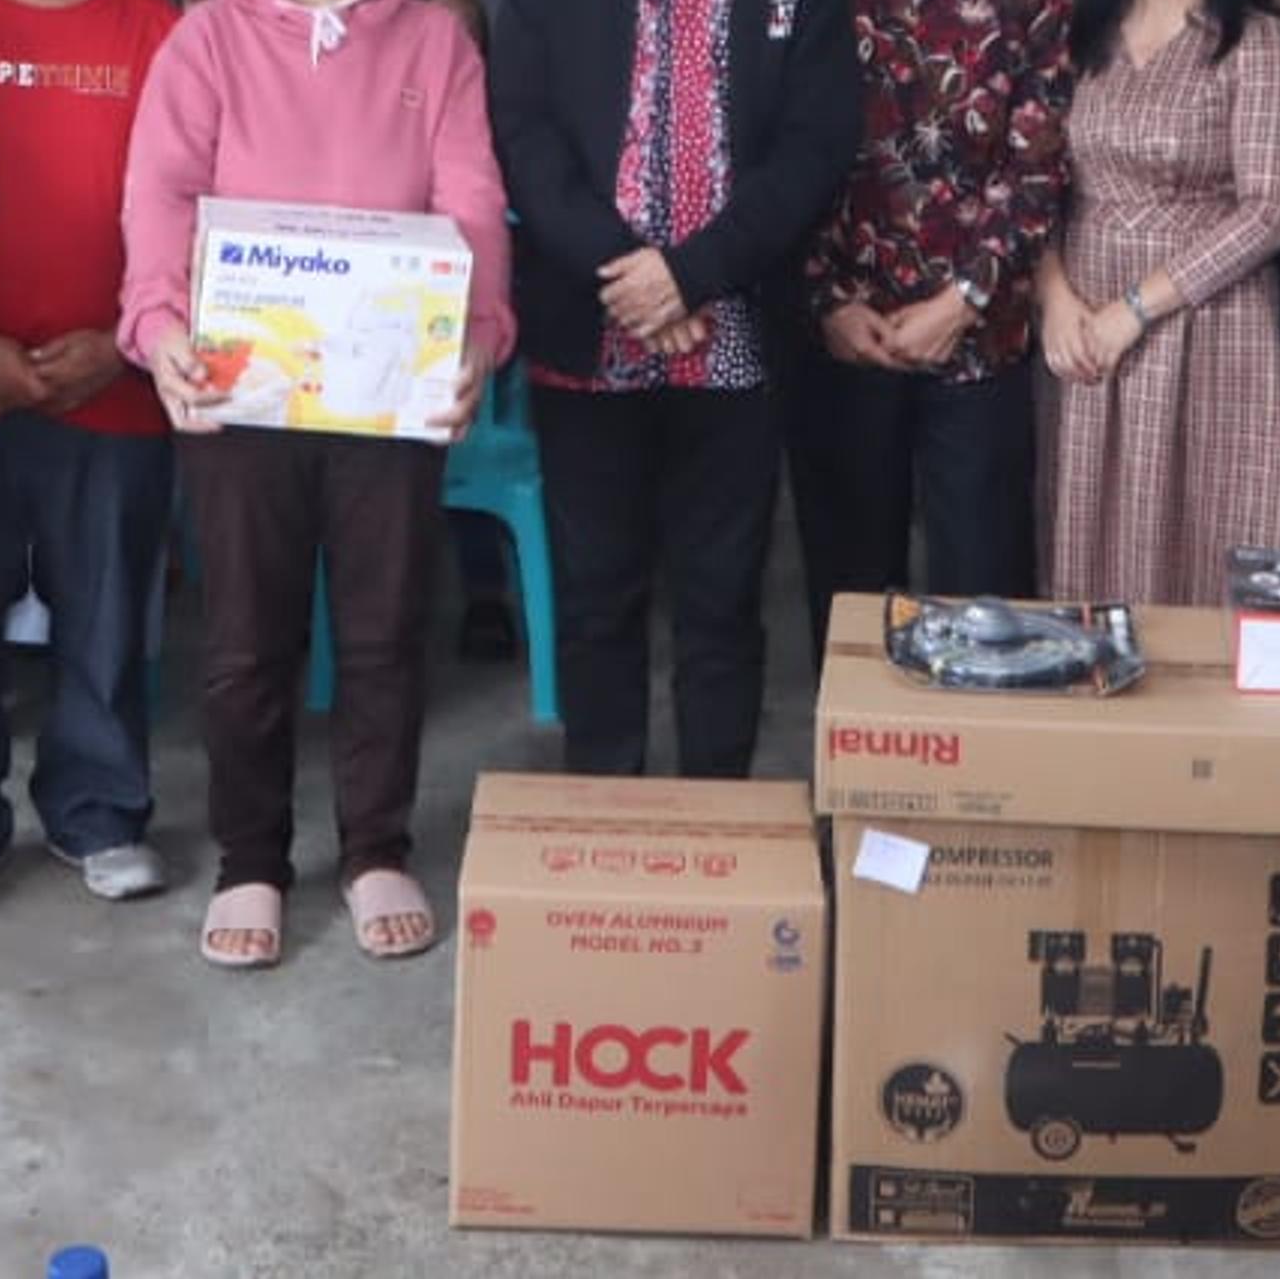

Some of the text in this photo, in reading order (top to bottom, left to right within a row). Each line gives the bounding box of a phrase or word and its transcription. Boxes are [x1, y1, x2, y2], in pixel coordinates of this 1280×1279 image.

[247, 245, 351, 276] Miyako
[828, 728, 960, 766] Rinnai
[928, 847, 1054, 868] OMPRESSOR
[546, 911, 606, 929] OVEN
[570, 934, 640, 953] MODEL
[511, 1018, 749, 1095] HOCK
[511, 1091, 552, 1109] Ahli
[558, 1094, 622, 1114] Dapur
